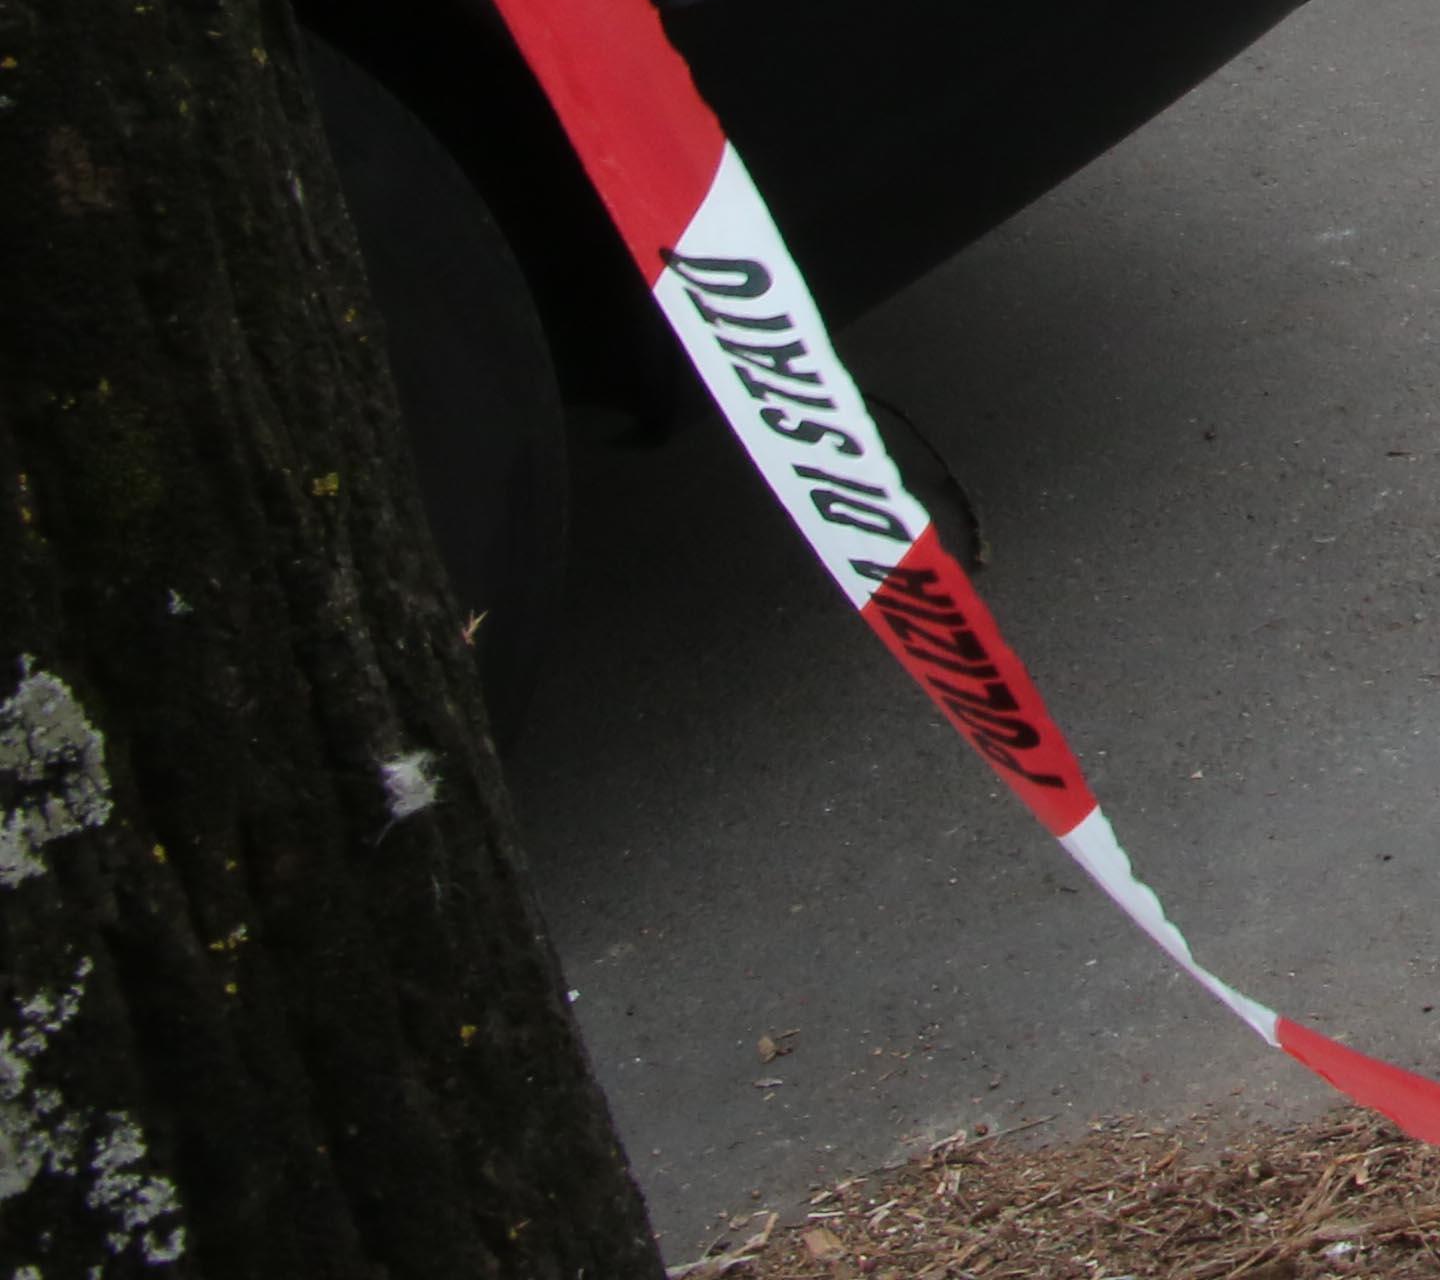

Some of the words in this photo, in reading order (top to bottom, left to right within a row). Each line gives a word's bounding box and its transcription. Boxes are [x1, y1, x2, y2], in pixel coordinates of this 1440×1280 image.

[659, 246, 866, 460] STATO
[791, 462, 917, 545] DI
[848, 557, 1067, 792] POLIZIA
